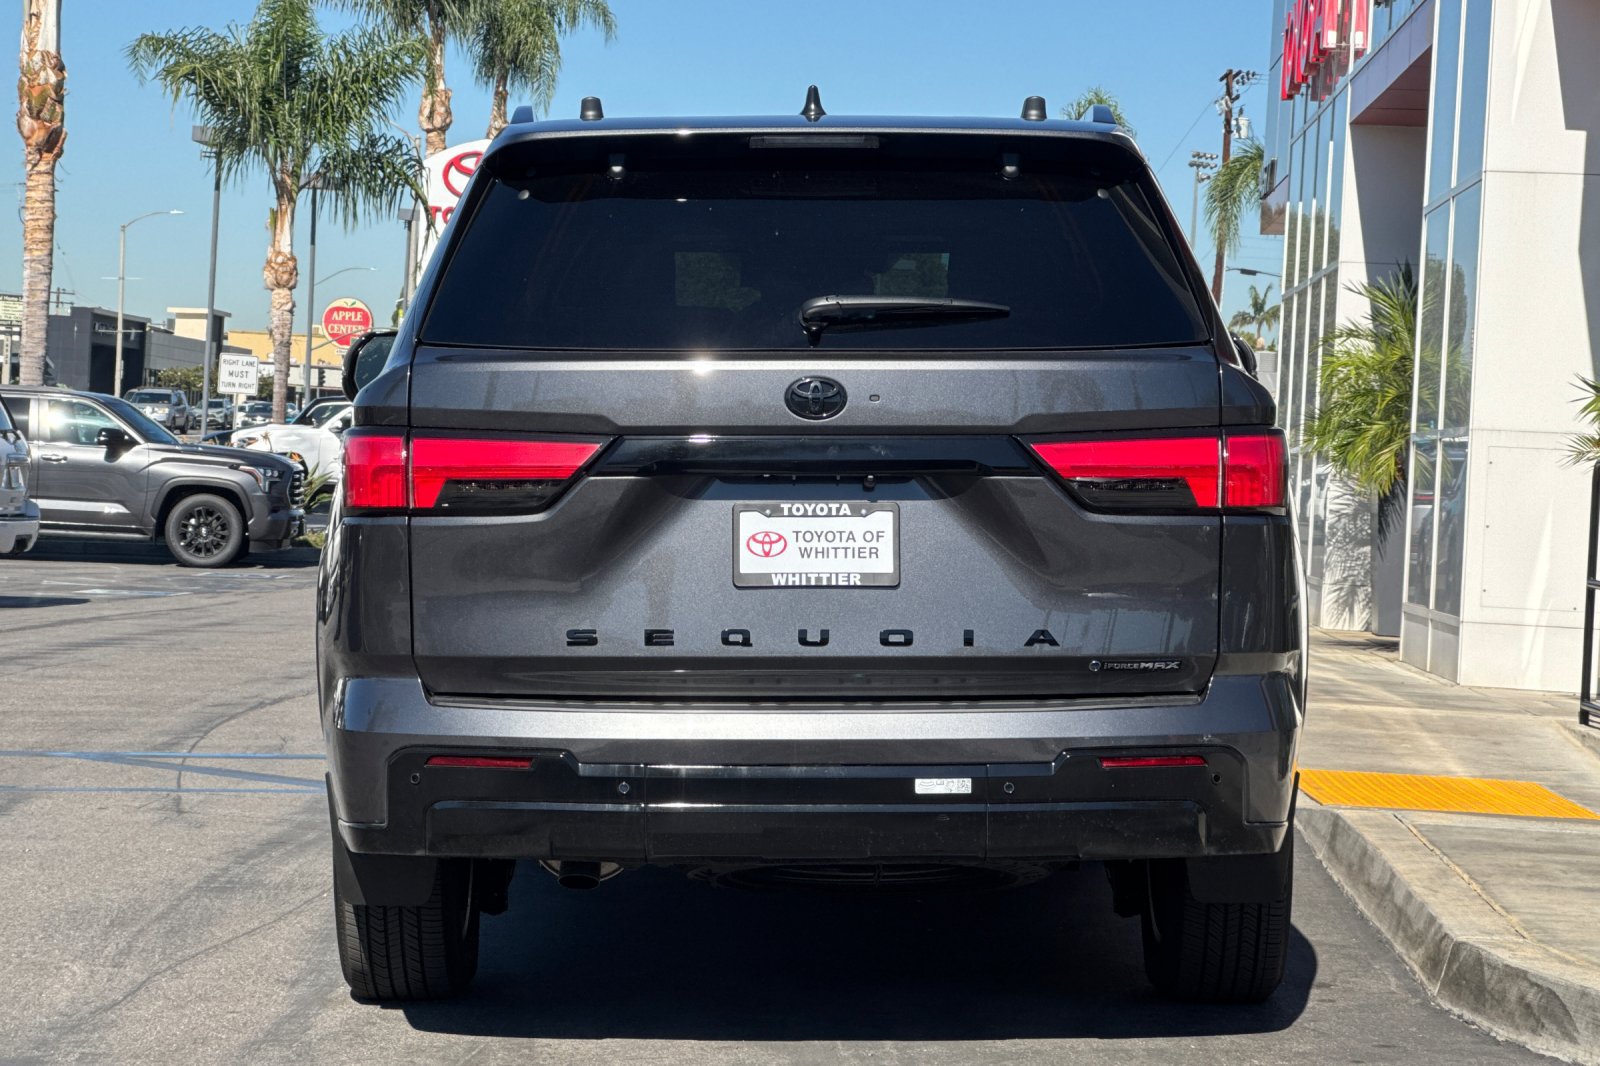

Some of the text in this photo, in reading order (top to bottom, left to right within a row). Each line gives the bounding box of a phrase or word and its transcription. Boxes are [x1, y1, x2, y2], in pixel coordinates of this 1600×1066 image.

[331, 310, 363, 321] APPLE
[222, 358, 257, 368] RIGHT LANE
[228, 370, 249, 379] MUST
[221, 381, 256, 390] TURN RIGHT
[780, 503, 852, 516] TOYOTA
[792, 530, 886, 543] TOYOTA OF
[798, 546, 880, 559] WHITTIER
[771, 573, 862, 586] WHITTIER
[566, 628, 1060, 647] SEQUOIA
